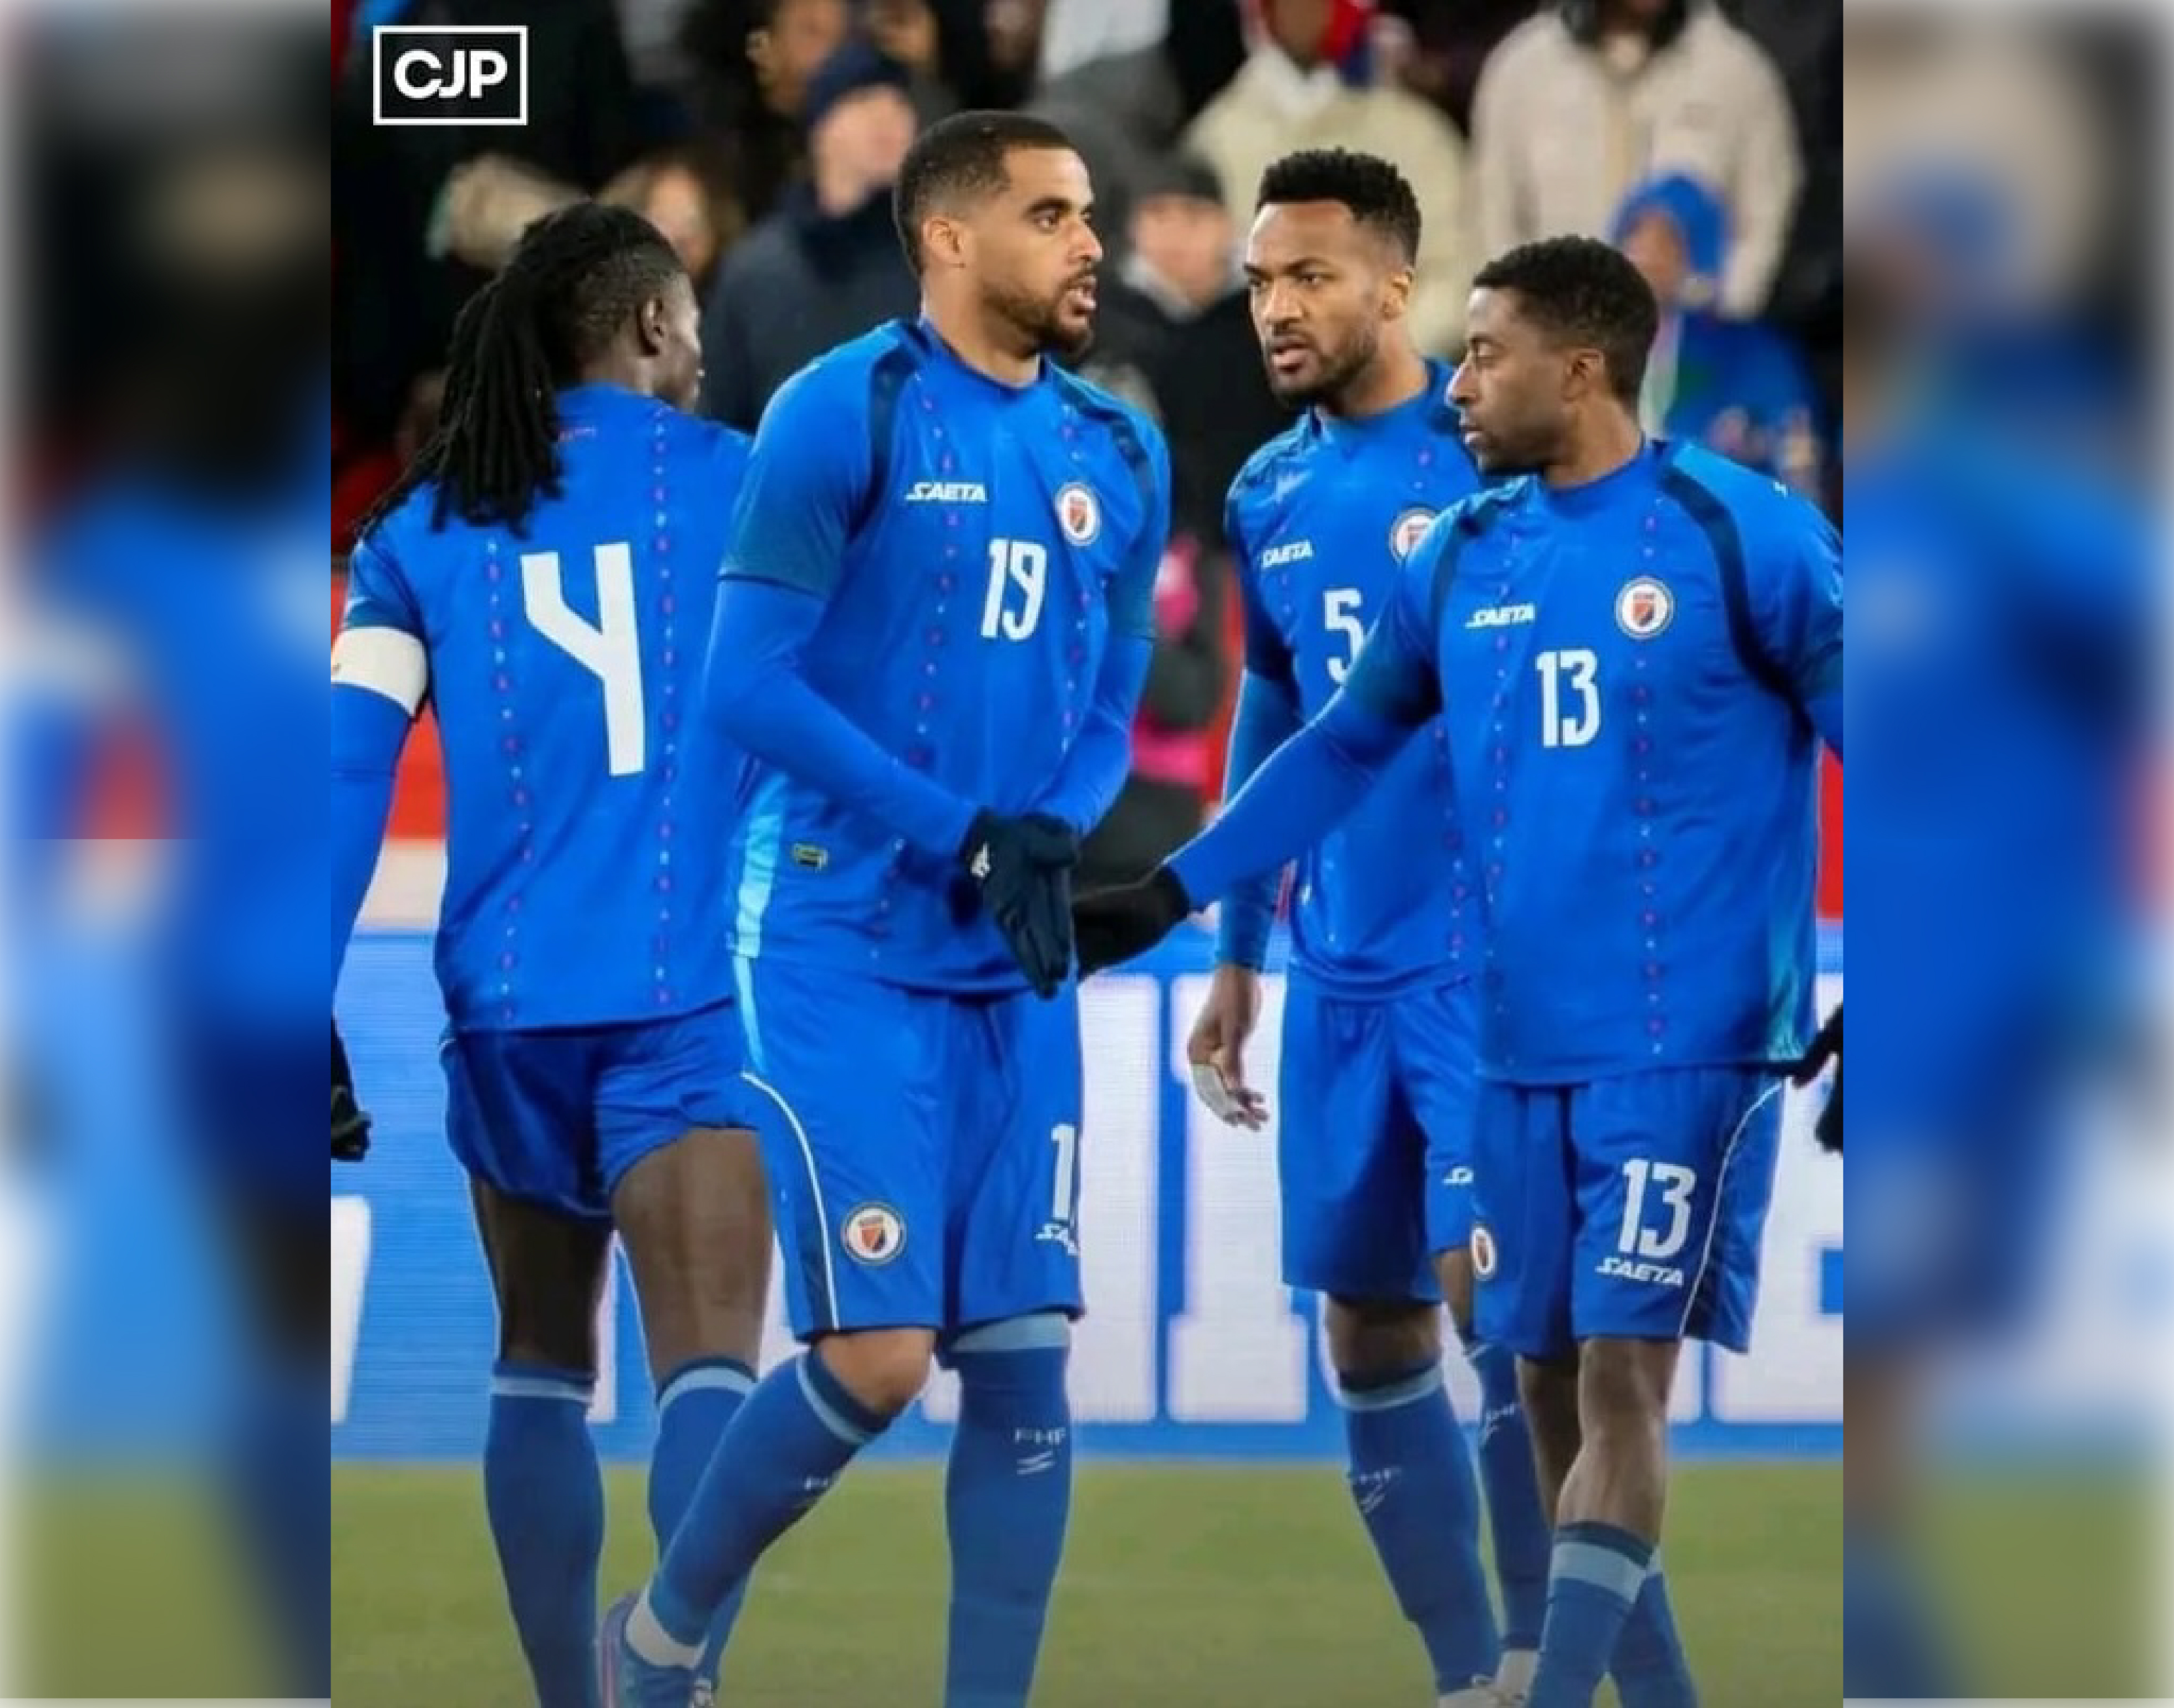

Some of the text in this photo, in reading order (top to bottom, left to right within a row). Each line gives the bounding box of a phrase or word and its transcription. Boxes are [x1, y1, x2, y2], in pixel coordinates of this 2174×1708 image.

[906, 481, 988, 502] SAETA
[981, 538, 1047, 640] 19
[1323, 588, 1364, 684] 5
[1464, 602, 1536, 629] SAETA
[520, 541, 646, 777] 4
[1536, 649, 1601, 748] 13
[1051, 1124, 1077, 1227] 1
[1618, 1158, 1696, 1257] 13
[1595, 1257, 1685, 1286] SAETA
